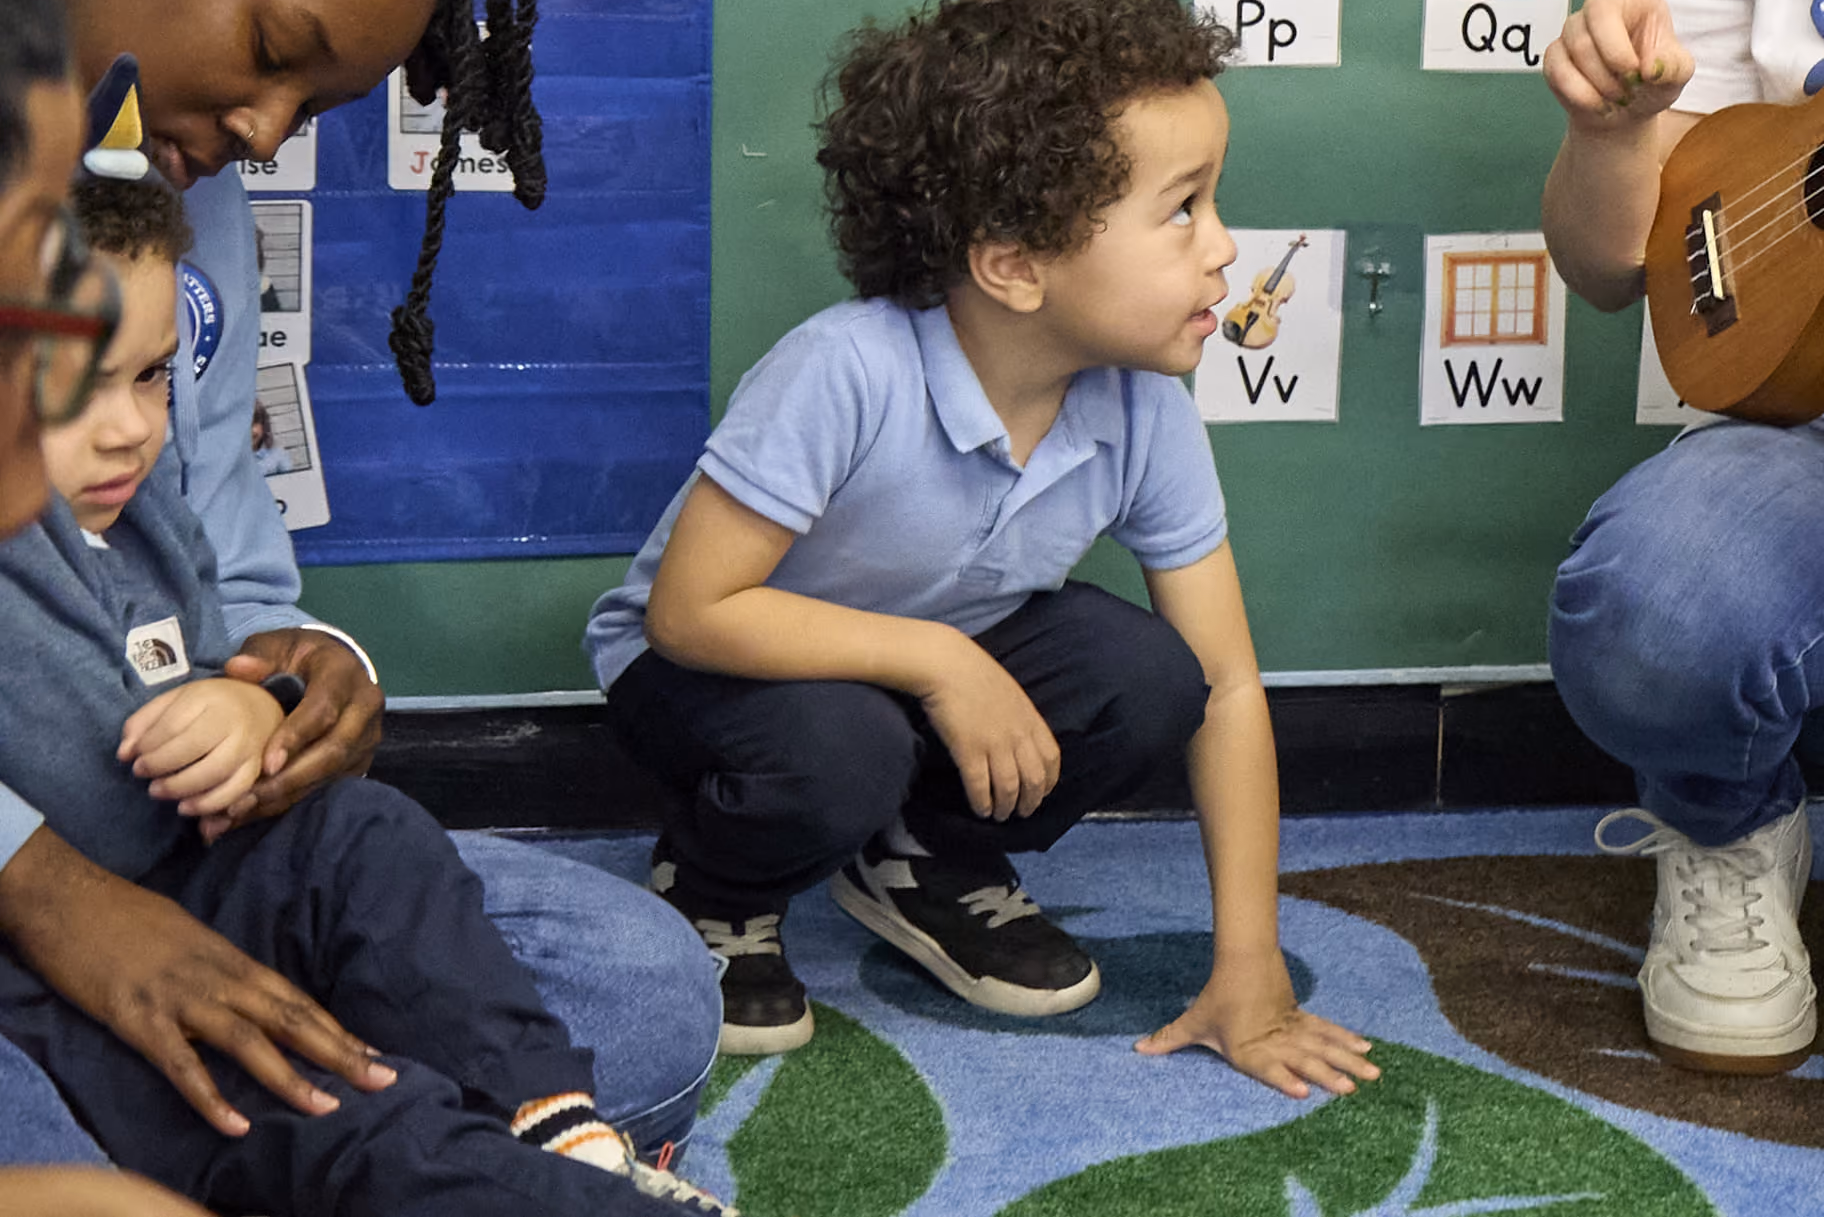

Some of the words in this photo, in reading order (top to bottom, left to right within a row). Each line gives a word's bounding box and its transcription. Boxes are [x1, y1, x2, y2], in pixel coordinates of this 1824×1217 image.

[1461, 2, 1540, 67] Qq
[1237, 355, 1299, 405] Vv
[1443, 357, 1543, 409] Ww
